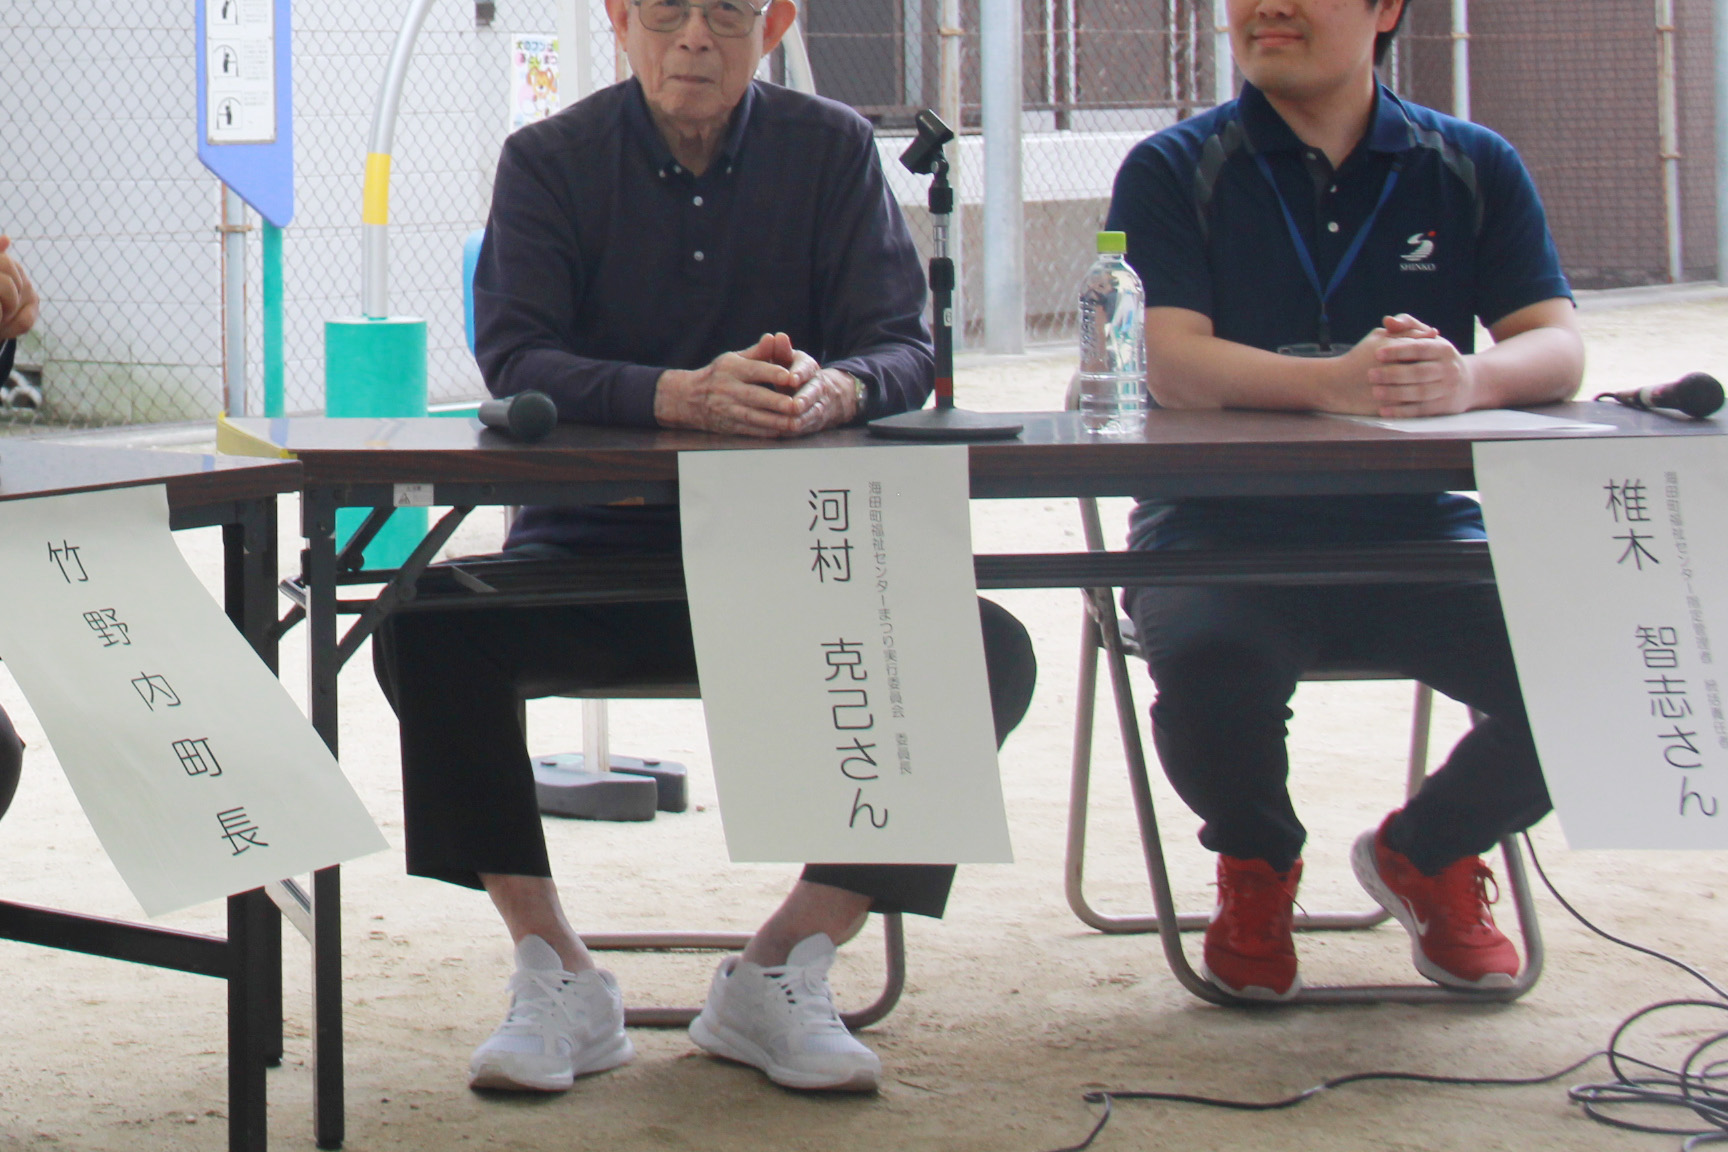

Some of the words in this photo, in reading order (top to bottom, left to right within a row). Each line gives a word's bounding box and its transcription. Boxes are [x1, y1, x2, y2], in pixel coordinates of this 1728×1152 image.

[808, 488, 854, 584] 河村
[1603, 478, 1660, 571] 椎木
[1634, 624, 1718, 818] 智志さん
[47, 539, 269, 856] 竹野内町長
[820, 637, 889, 830] 克己さん
